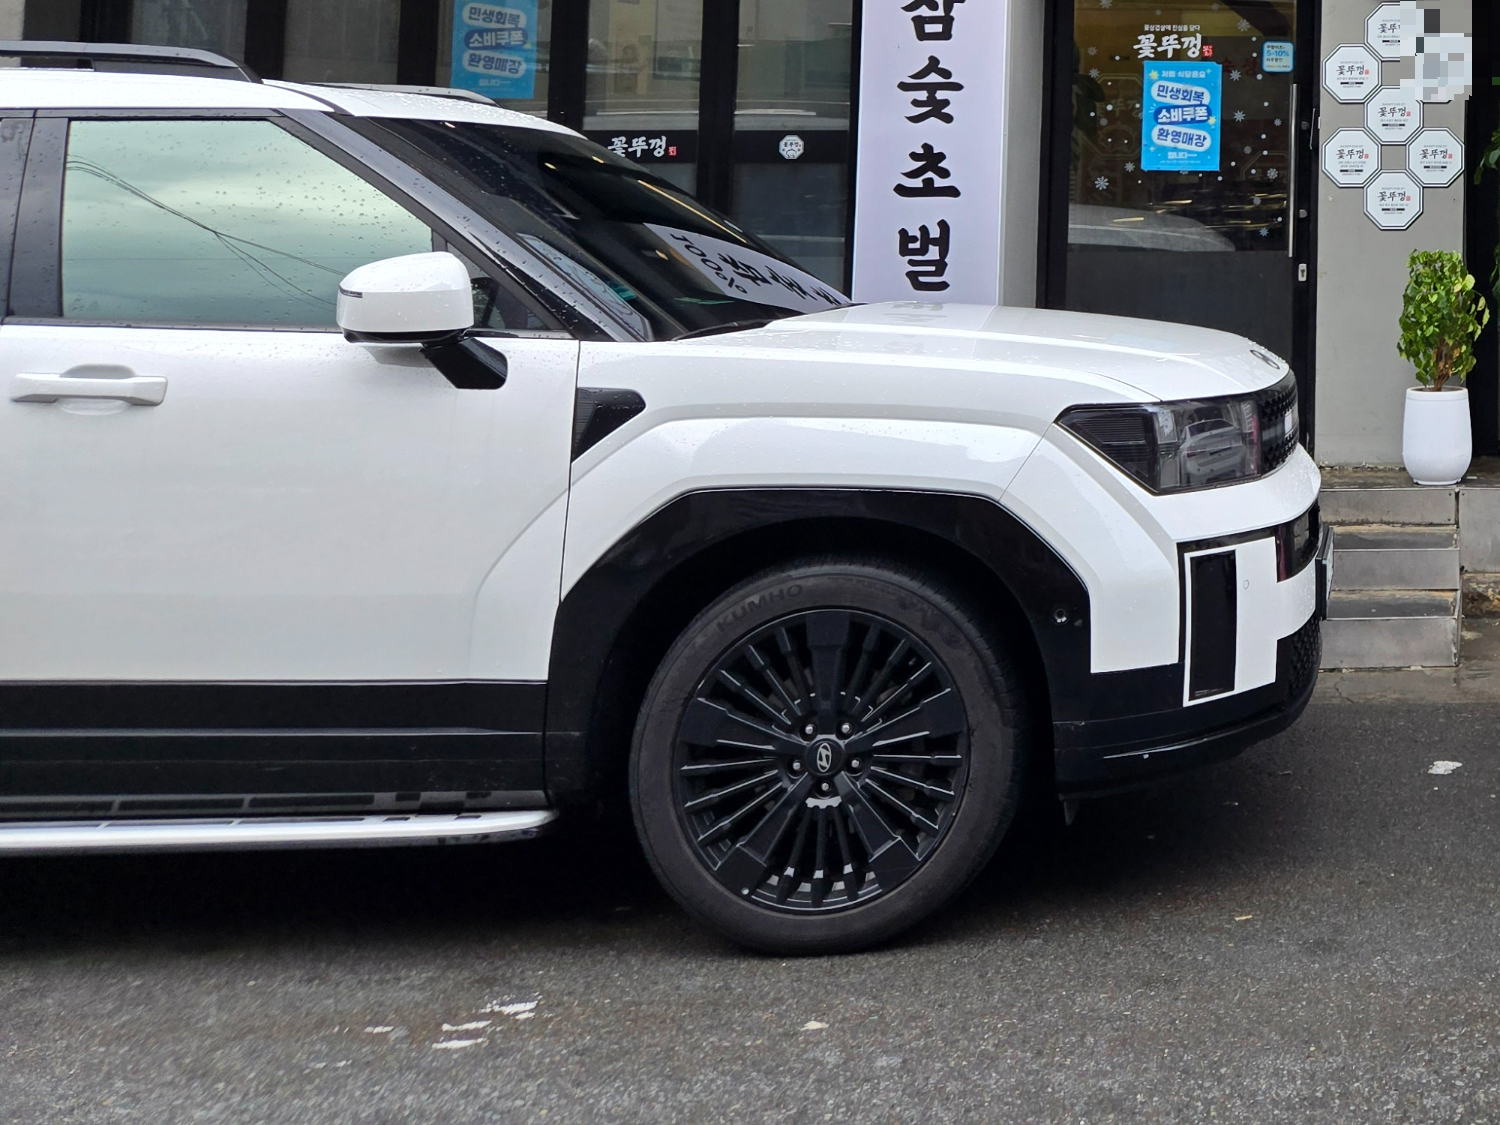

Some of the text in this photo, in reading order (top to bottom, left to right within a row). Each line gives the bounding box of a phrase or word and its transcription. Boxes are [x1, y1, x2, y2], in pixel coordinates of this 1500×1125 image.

[468, 6, 520, 28] 민생회복
[469, 30, 524, 48] 소비쿠폰
[1133, 33, 1202, 59] 꽃뚜껑
[468, 53, 522, 75] 환영매장
[1156, 84, 1205, 105] 민생회복
[1157, 106, 1208, 123] 소비쿠폰
[607, 135, 667, 158] 꽃뚜껑
[1156, 127, 1207, 148] 환영매장
[716, 584, 804, 632] KUMHO
